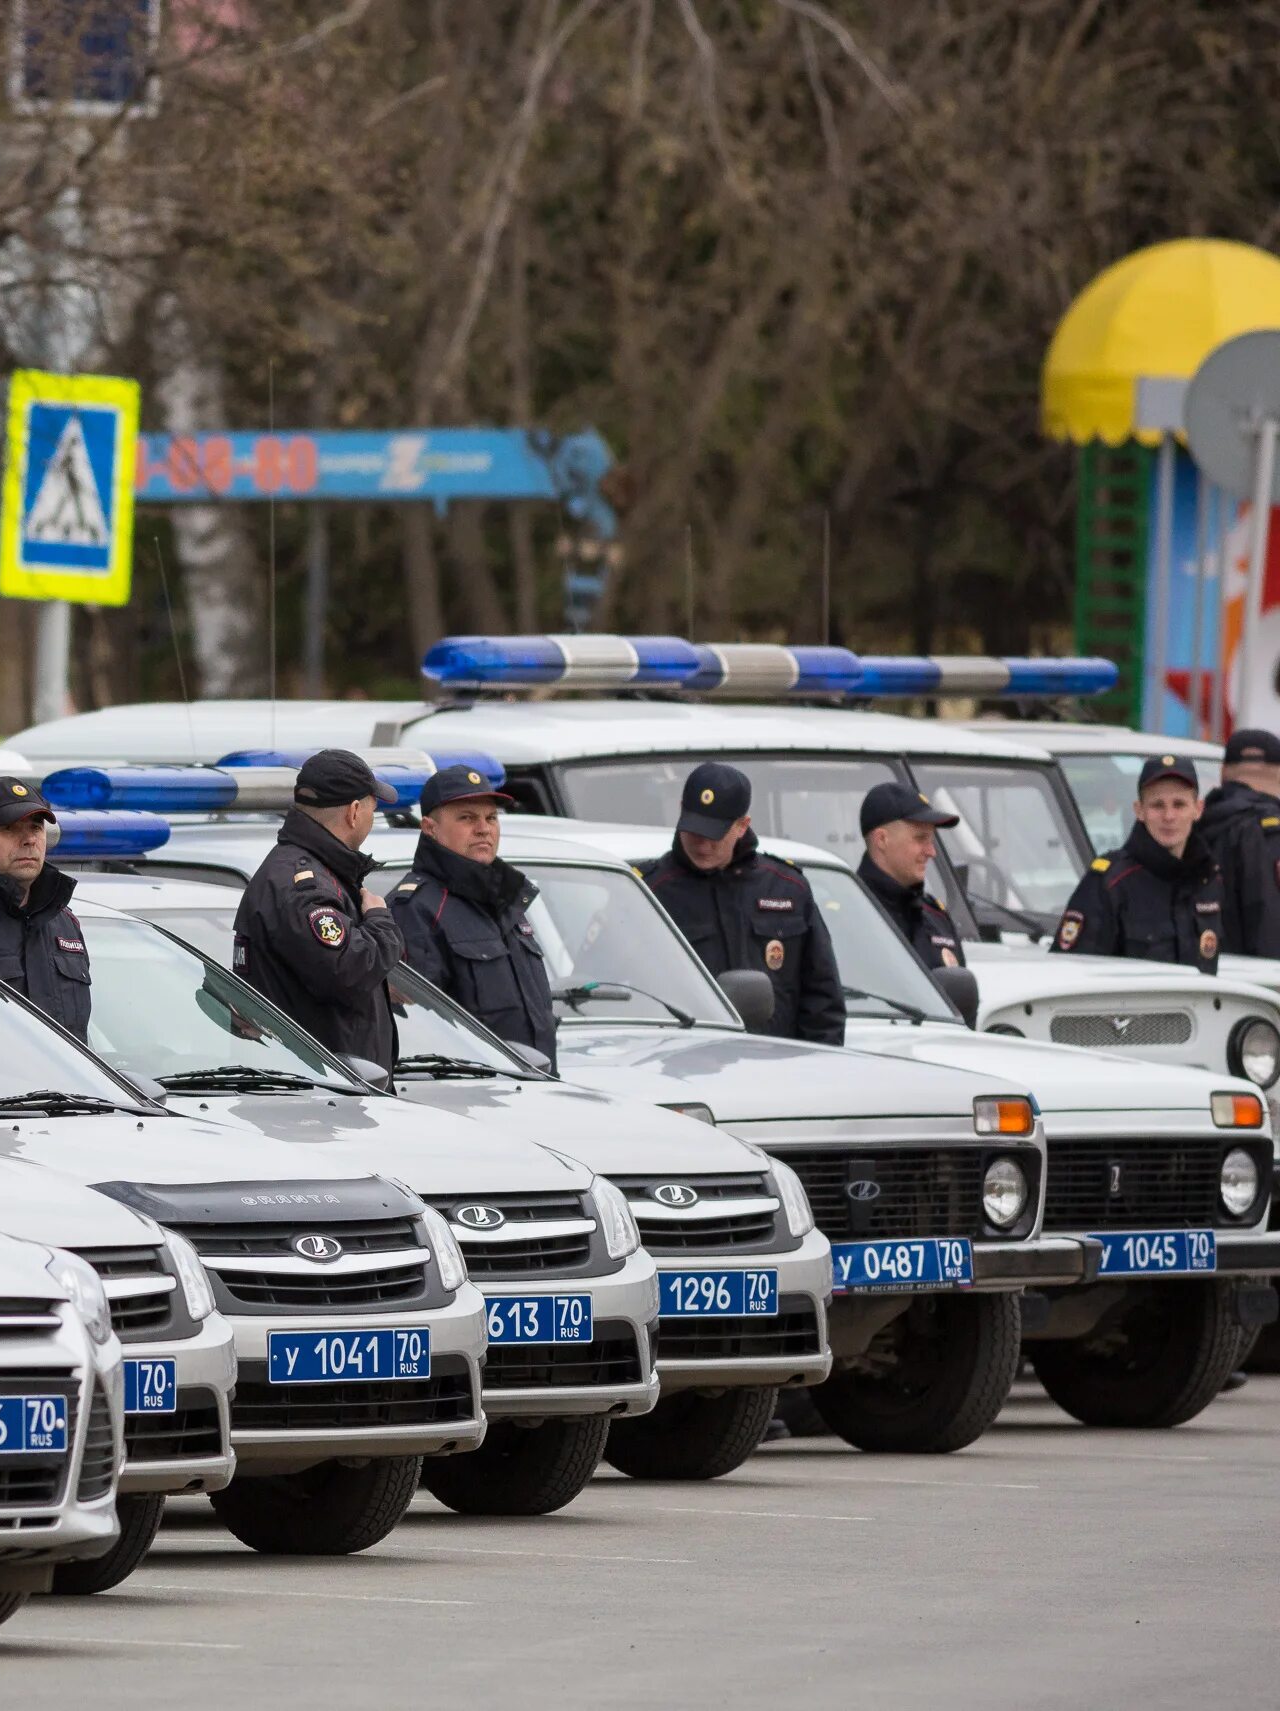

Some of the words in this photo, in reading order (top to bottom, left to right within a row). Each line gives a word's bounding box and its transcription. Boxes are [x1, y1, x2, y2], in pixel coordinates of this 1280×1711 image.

[241, 1194, 340, 1206] GRANTA
[864, 1244, 924, 1279] 0487
[940, 1241, 963, 1267] 70
[1122, 1236, 1177, 1268] 1045
[1188, 1233, 1209, 1258] 70
[945, 1267, 962, 1277] RUS
[669, 1276, 731, 1311] 1296
[746, 1274, 769, 1300] 70
[749, 1301, 767, 1311] RUS
[488, 1301, 539, 1338] 613
[557, 1298, 583, 1326] 70
[561, 1327, 580, 1338] RUS
[314, 1336, 379, 1375] 1041
[397, 1333, 421, 1362] 70
[400, 1363, 418, 1374] RUS
[141, 1364, 166, 1395] 70
[144, 1396, 163, 1407] RUS
[27, 1401, 56, 1432] 70
[31, 1434, 53, 1446] RUS
